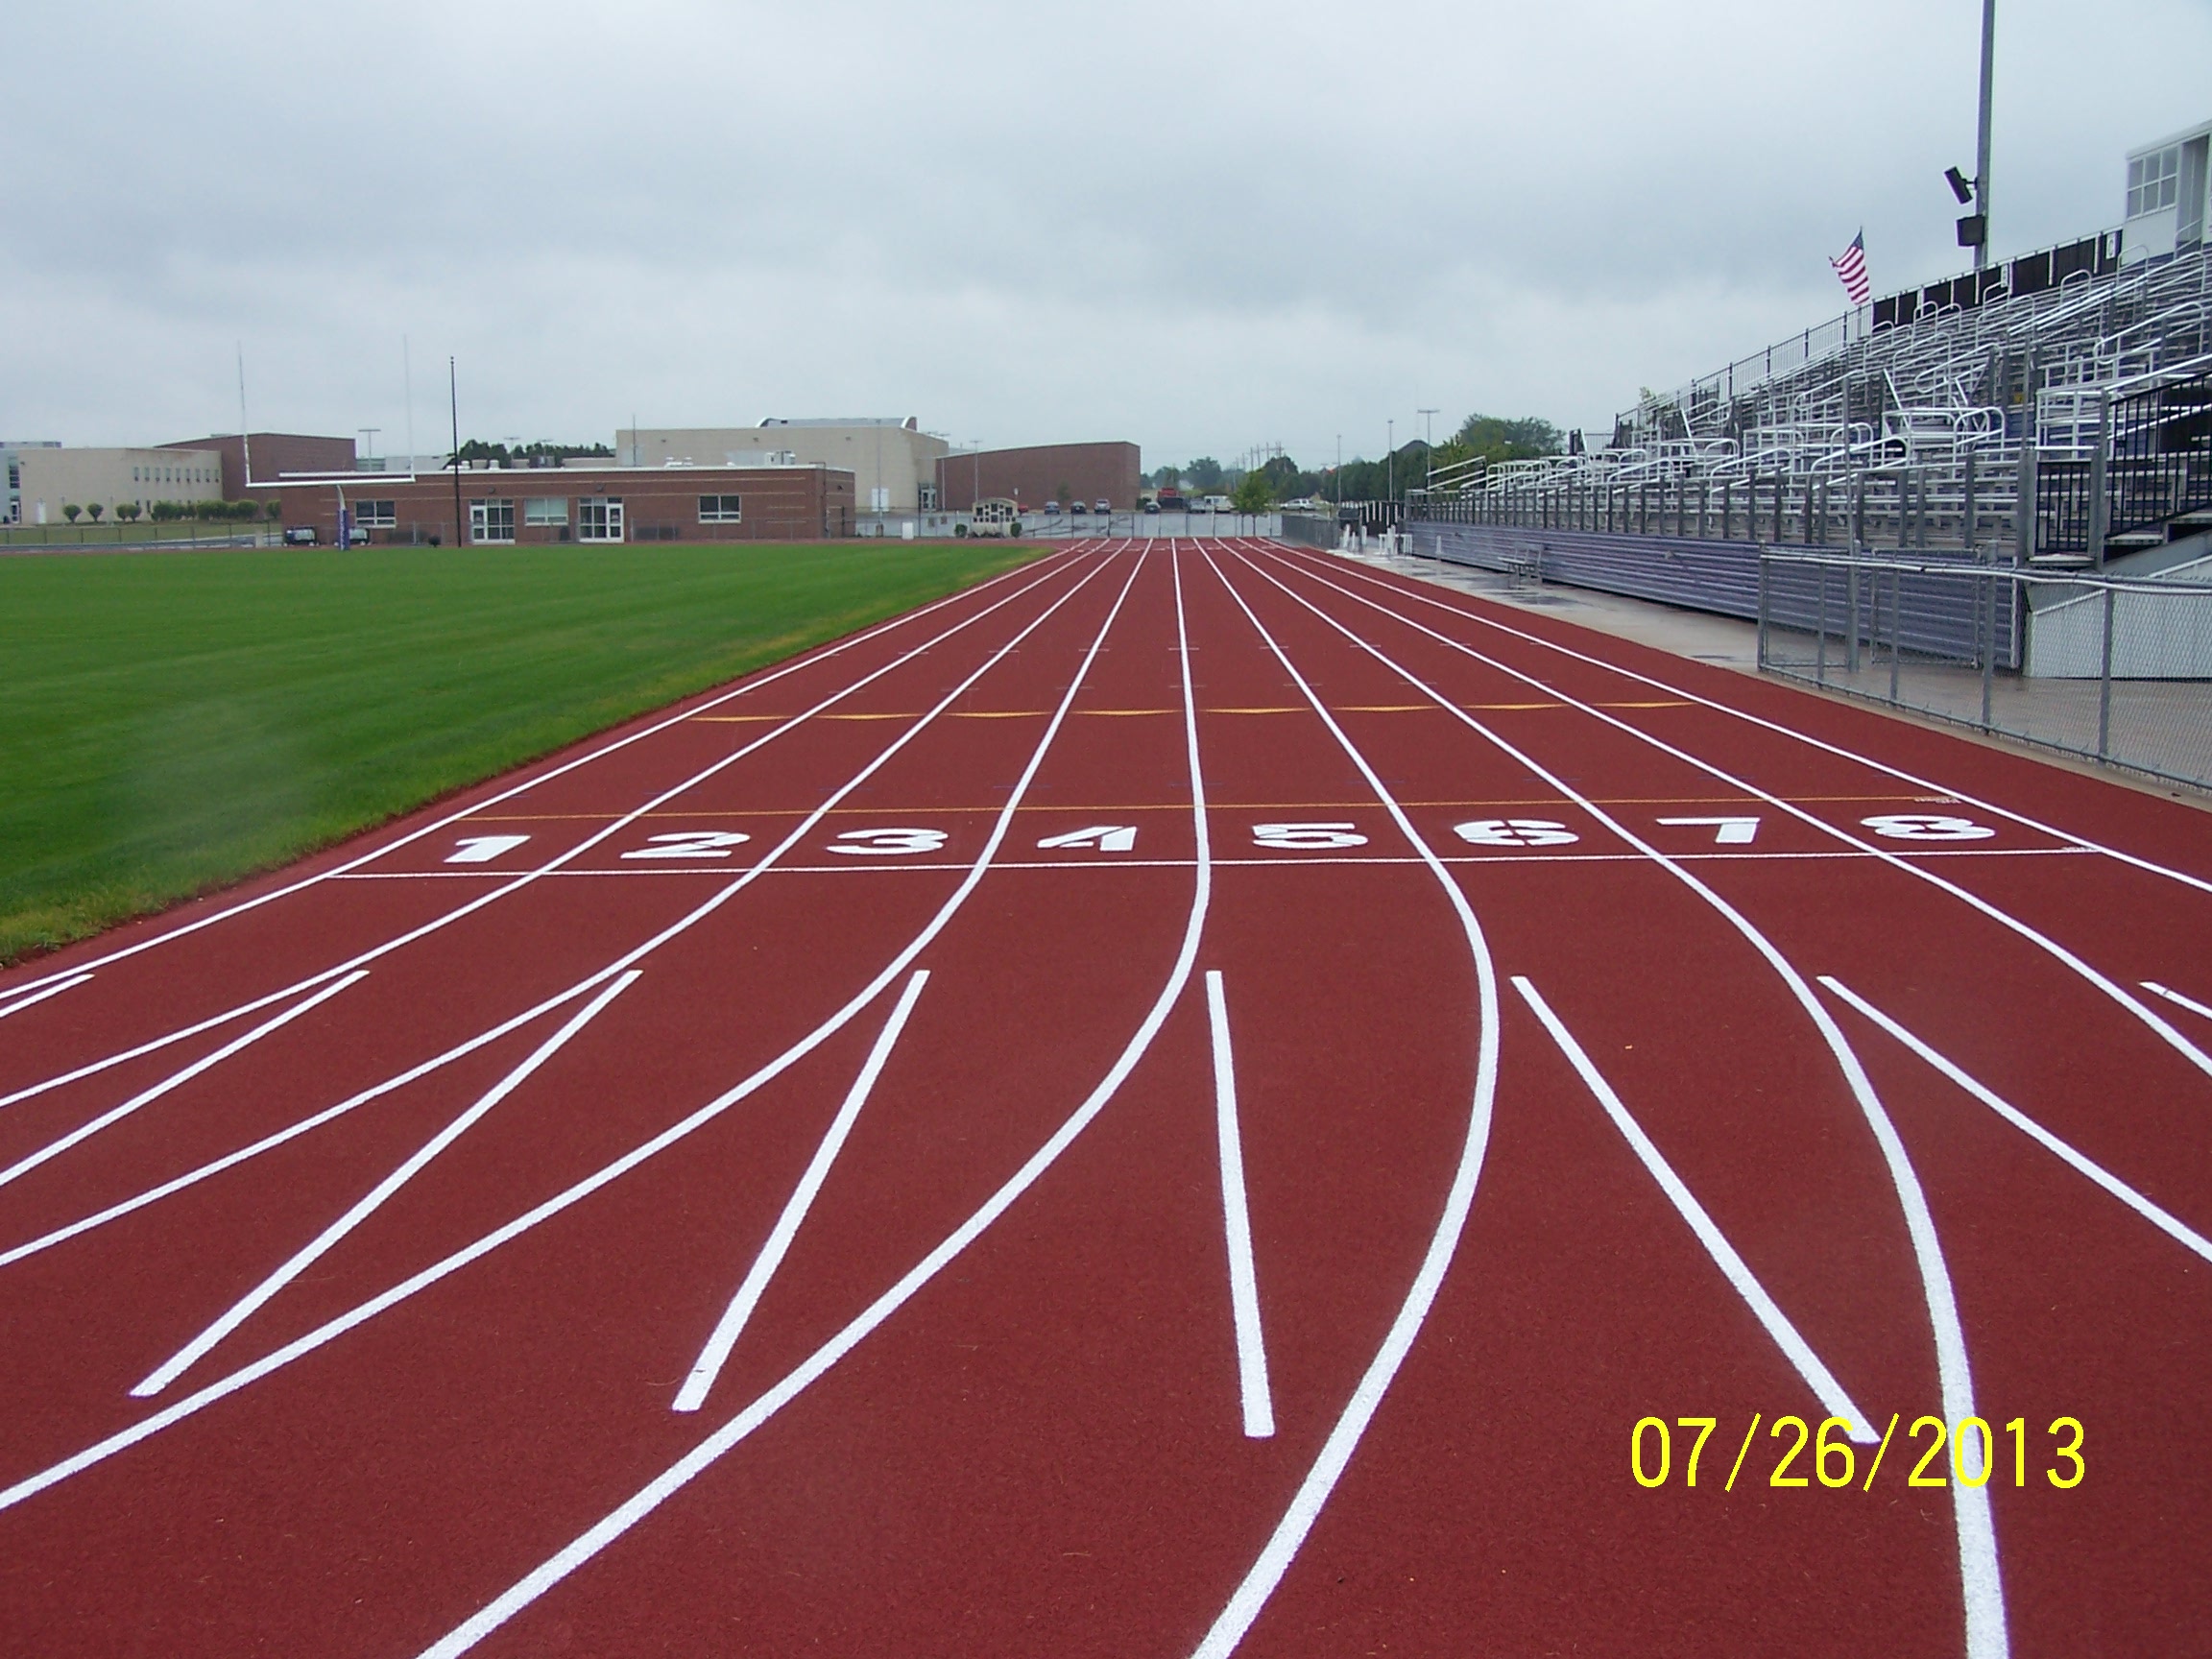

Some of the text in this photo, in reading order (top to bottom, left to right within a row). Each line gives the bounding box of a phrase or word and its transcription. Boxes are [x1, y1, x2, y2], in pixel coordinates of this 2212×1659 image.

[443, 814, 1996, 863] 1 2 3 4 5 6 7 8
